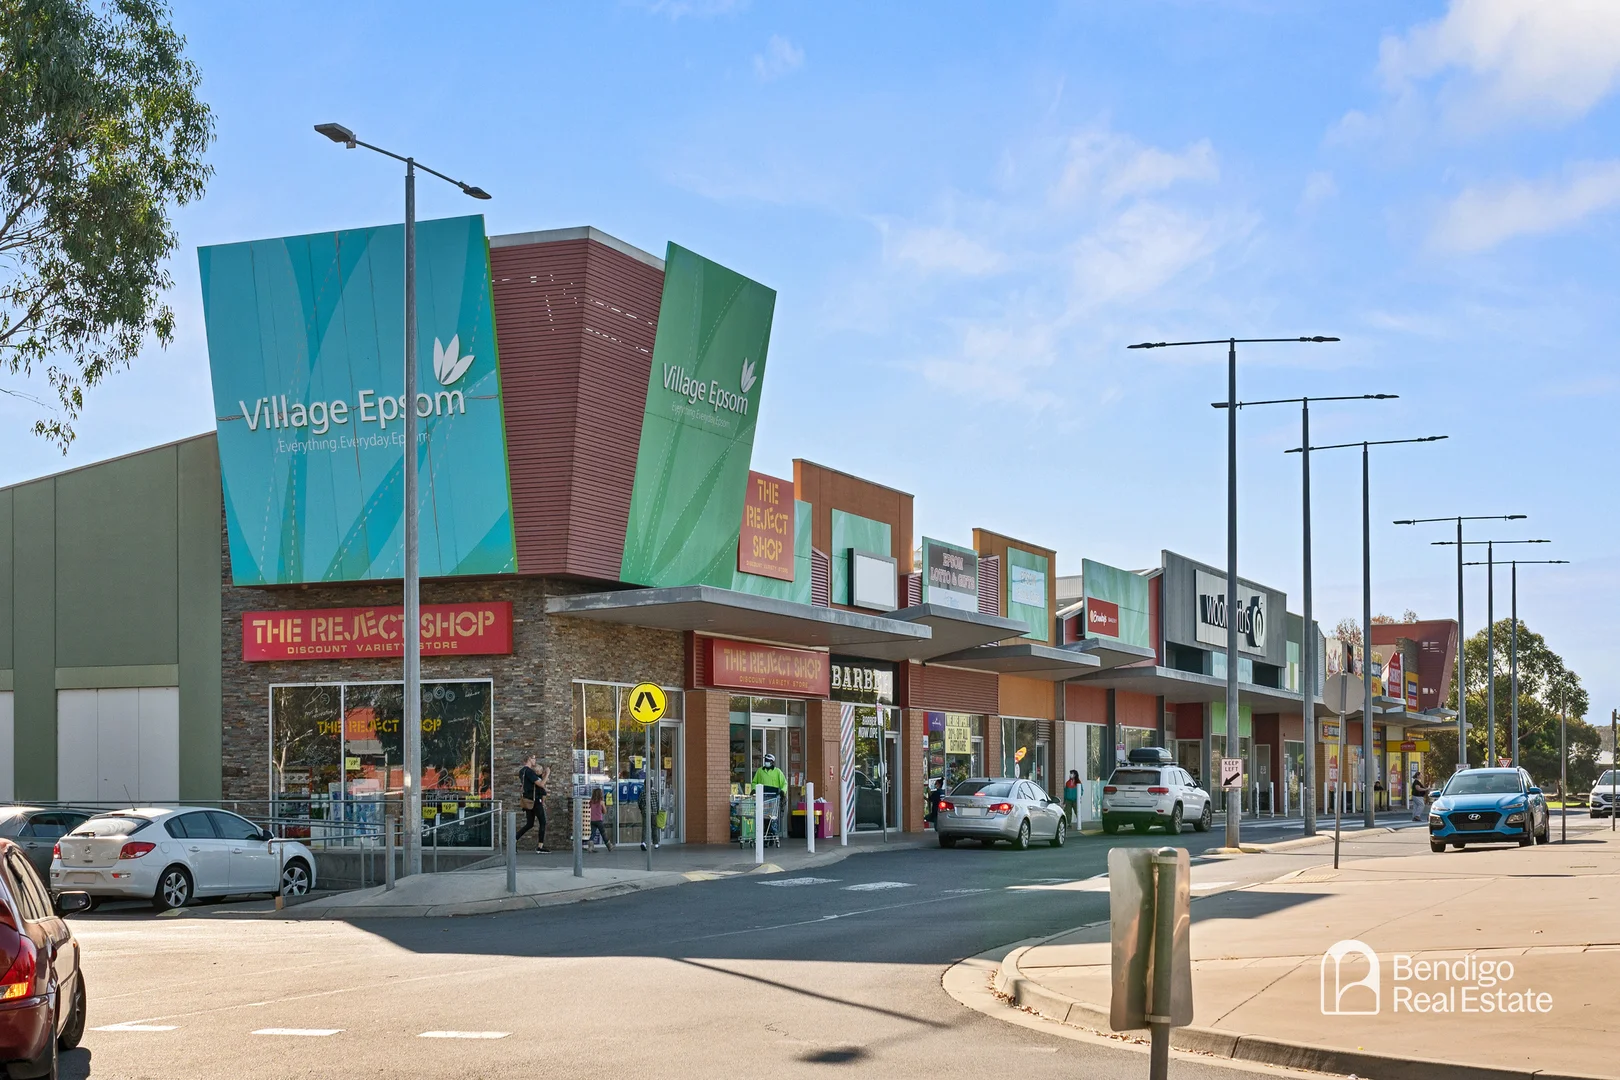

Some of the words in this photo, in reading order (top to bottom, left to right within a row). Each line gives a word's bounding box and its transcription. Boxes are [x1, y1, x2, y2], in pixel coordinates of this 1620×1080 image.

[663, 362, 706, 405] Village
[708, 379, 749, 416] Epsom
[239, 394, 348, 435] Village
[757, 478, 778, 504] THE
[747, 505, 788, 535] REJECT
[753, 535, 782, 561] SHOP
[943, 552, 964, 571] EPSOM
[930, 566, 951, 584] LOTTO
[958, 574, 976, 590] GIFTS
[253, 619, 302, 644] THE
[421, 610, 495, 638] SHOP
[287, 644, 347, 654] DISCOUNT
[419, 641, 458, 650] STORE
[724, 648, 747, 673] THE
[749, 651, 791, 677] REJECT
[794, 656, 822, 680] SHOP
[739, 675, 766, 685] DISCOUNT
[769, 679, 791, 688] VARIETY
[792, 681, 809, 689] STORE
[317, 721, 342, 733] THE
[349, 718, 400, 732] REJECT
[420, 718, 442, 732] OP
